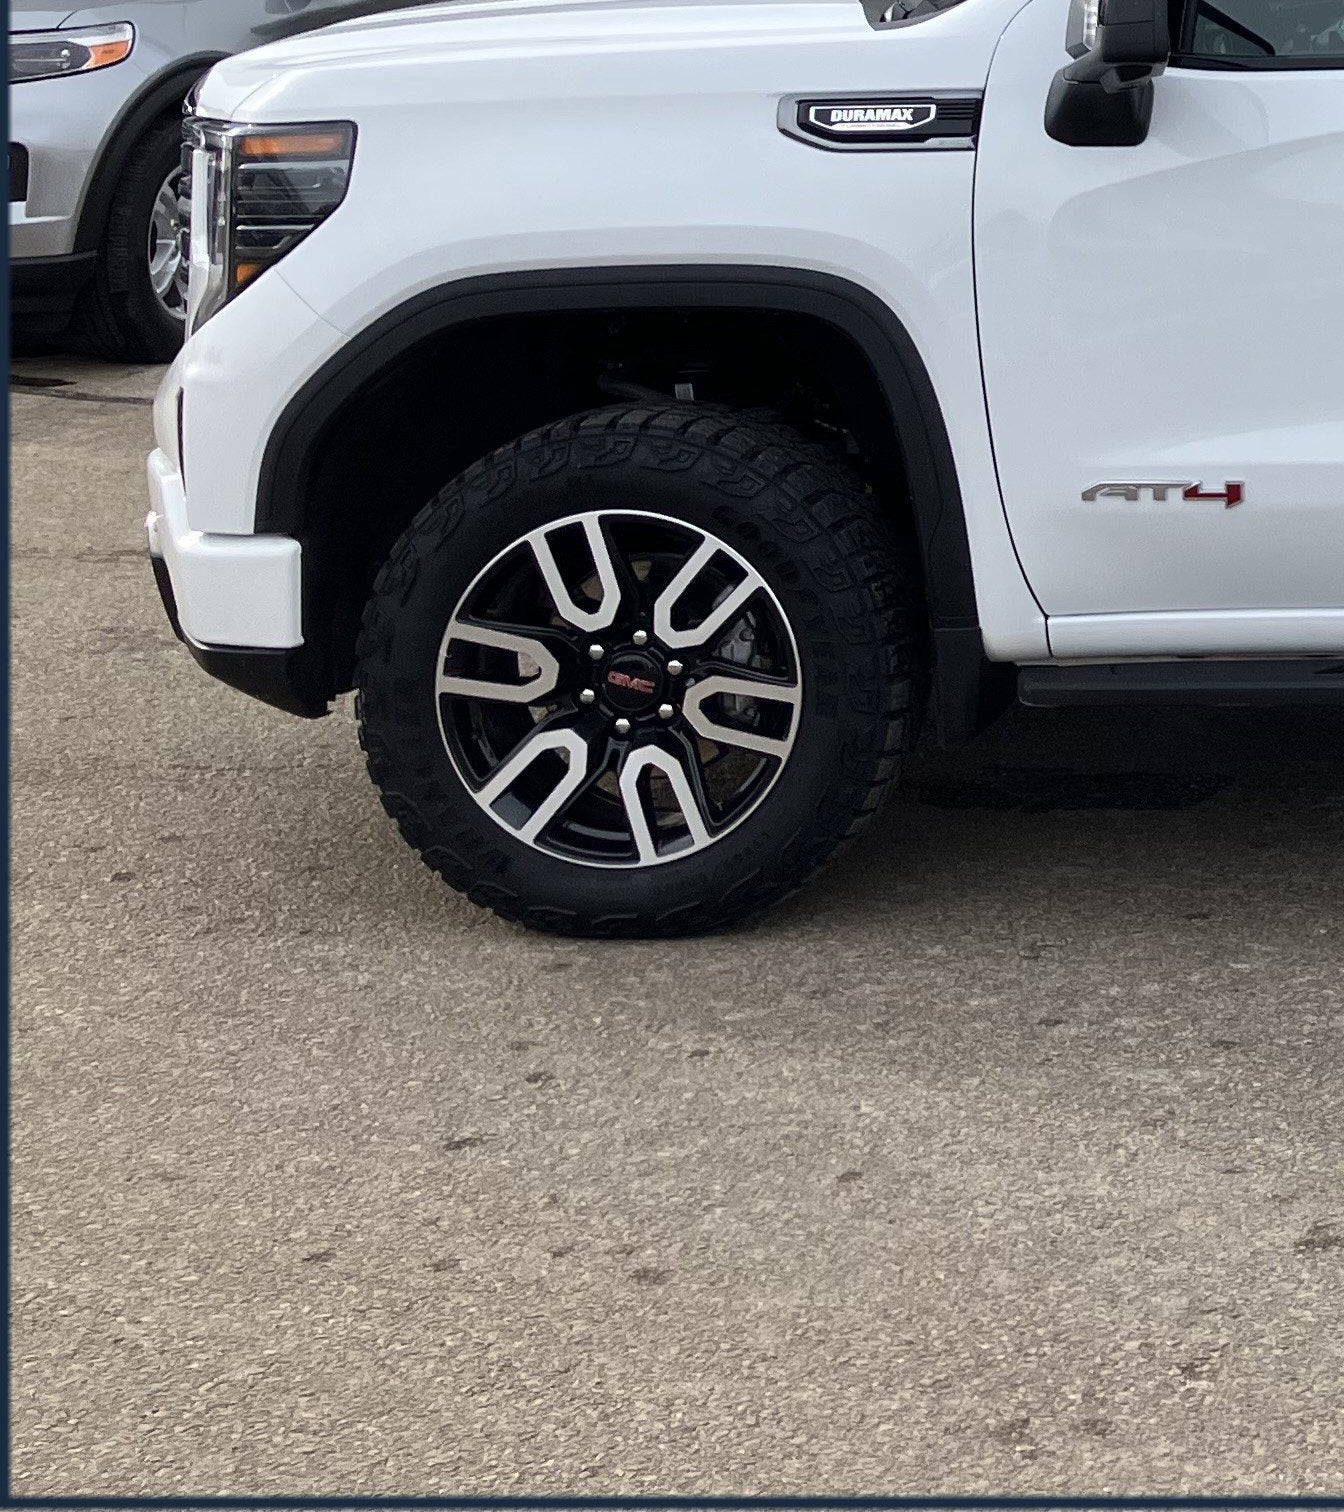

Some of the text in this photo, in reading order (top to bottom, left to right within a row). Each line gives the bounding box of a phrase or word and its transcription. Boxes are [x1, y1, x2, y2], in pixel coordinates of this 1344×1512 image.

[830, 108, 914, 122] DURAMAX
[1082, 481, 1243, 509] AT4
[607, 671, 656, 694] GMC
